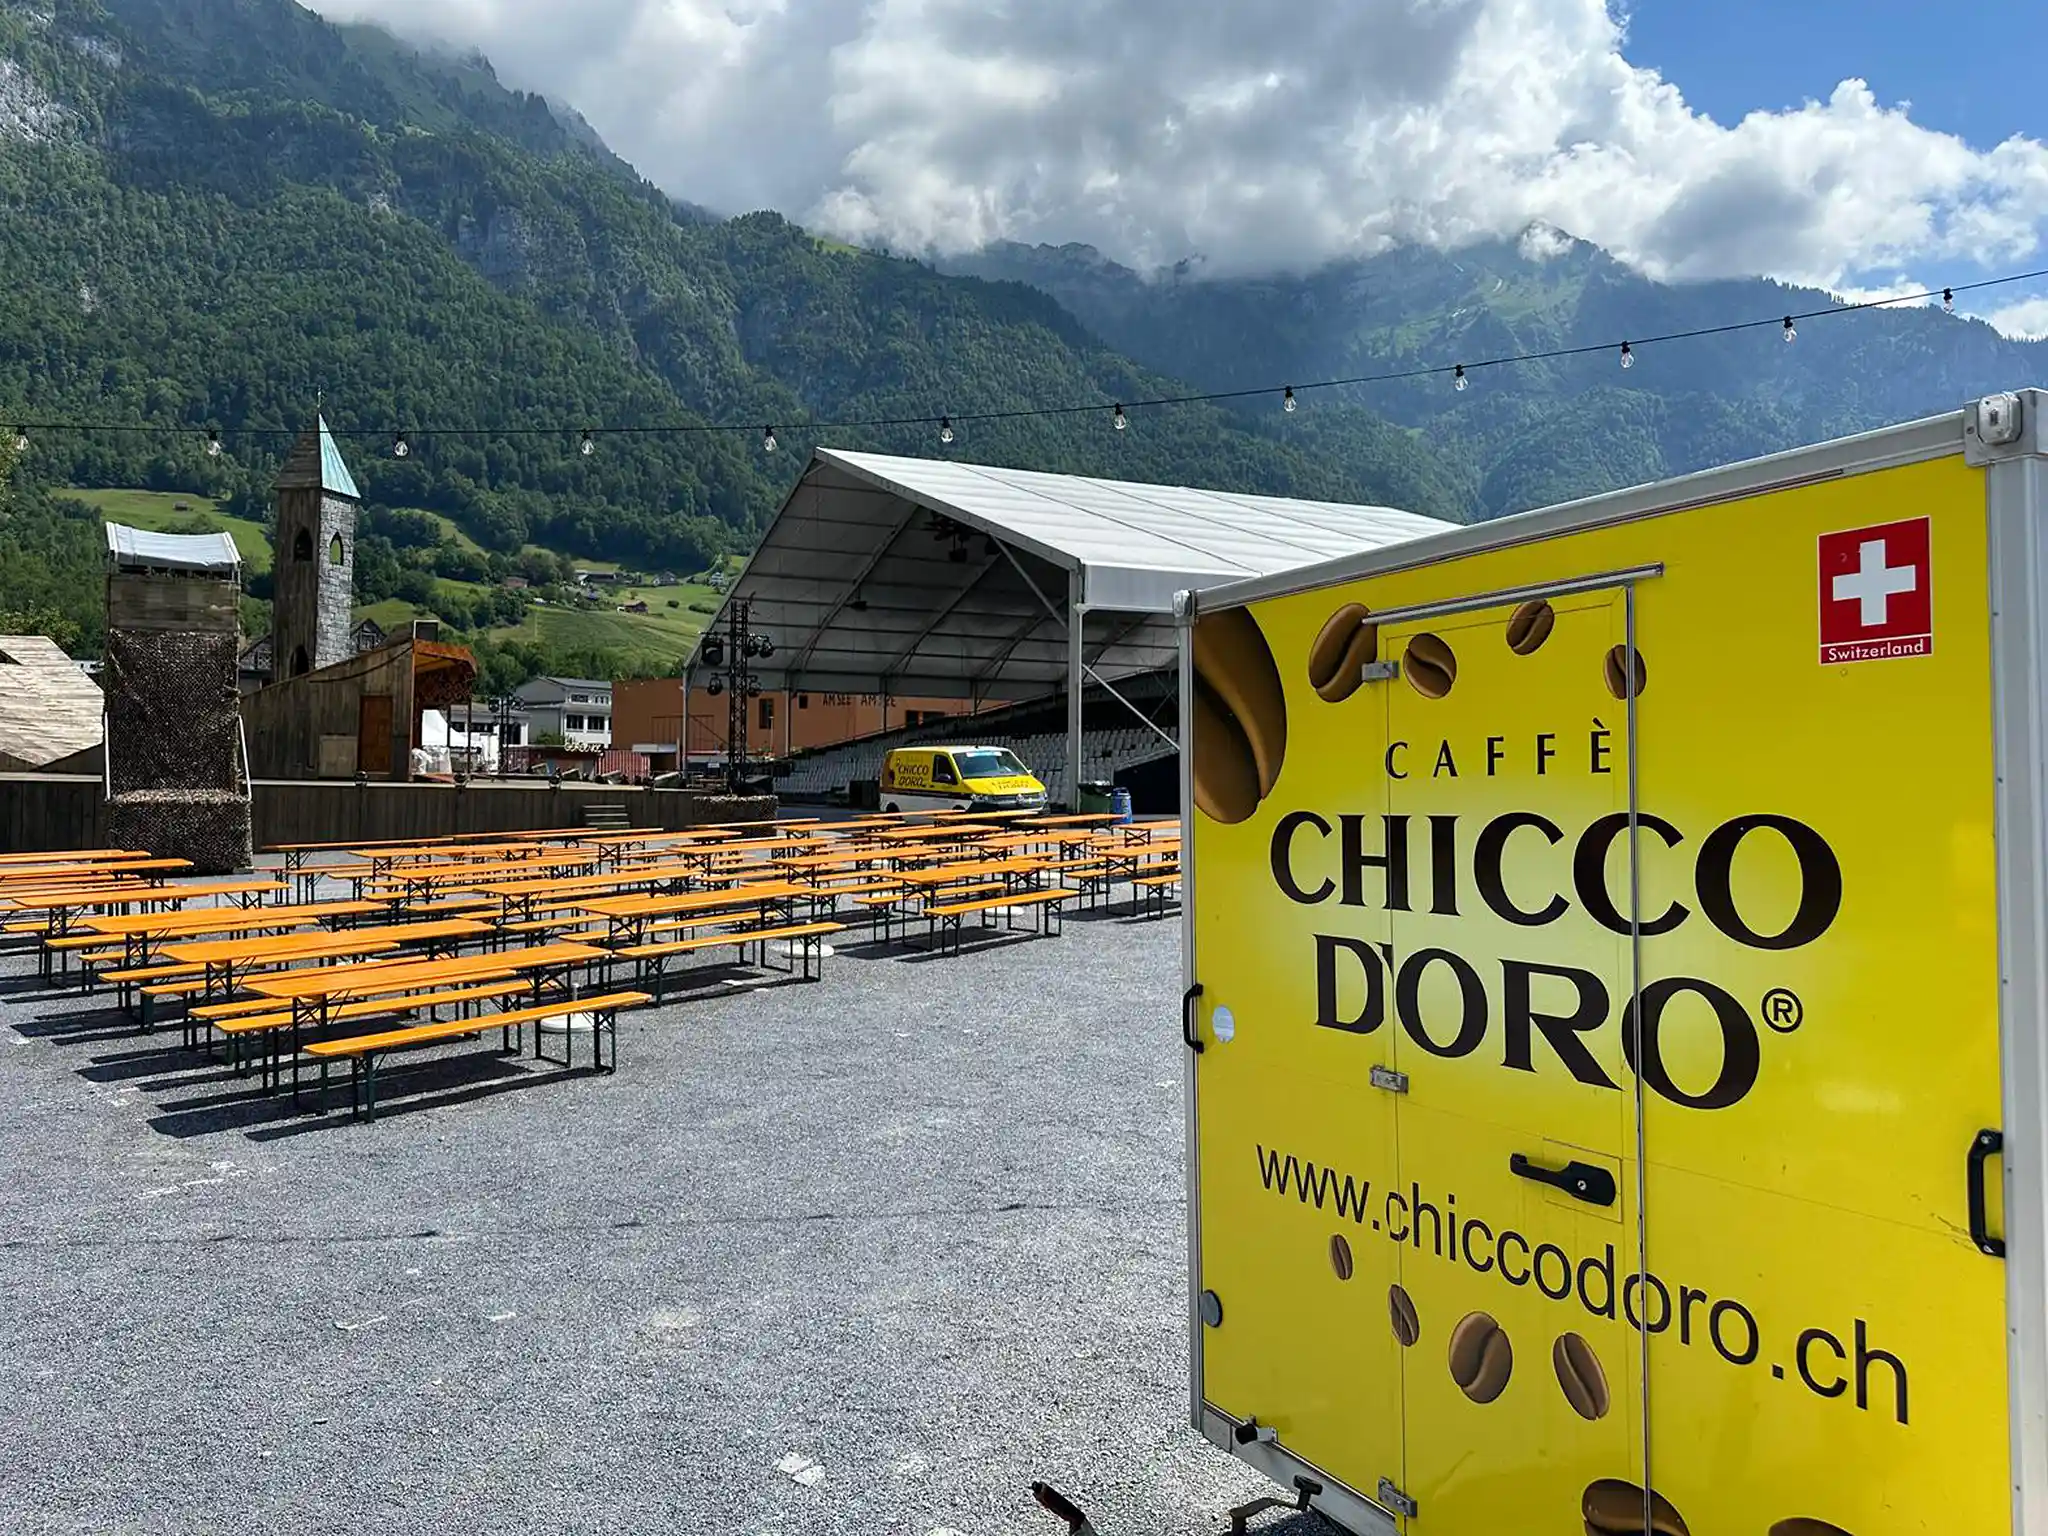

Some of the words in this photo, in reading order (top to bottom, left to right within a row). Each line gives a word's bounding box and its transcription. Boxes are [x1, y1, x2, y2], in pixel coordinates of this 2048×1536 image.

[1828, 638, 1925, 661] Switzerland
[1384, 716, 1612, 780] CAFFÈ
[1271, 811, 1842, 951] CHICCO
[1256, 1144, 1909, 1425] www.chiccodoro.ch
